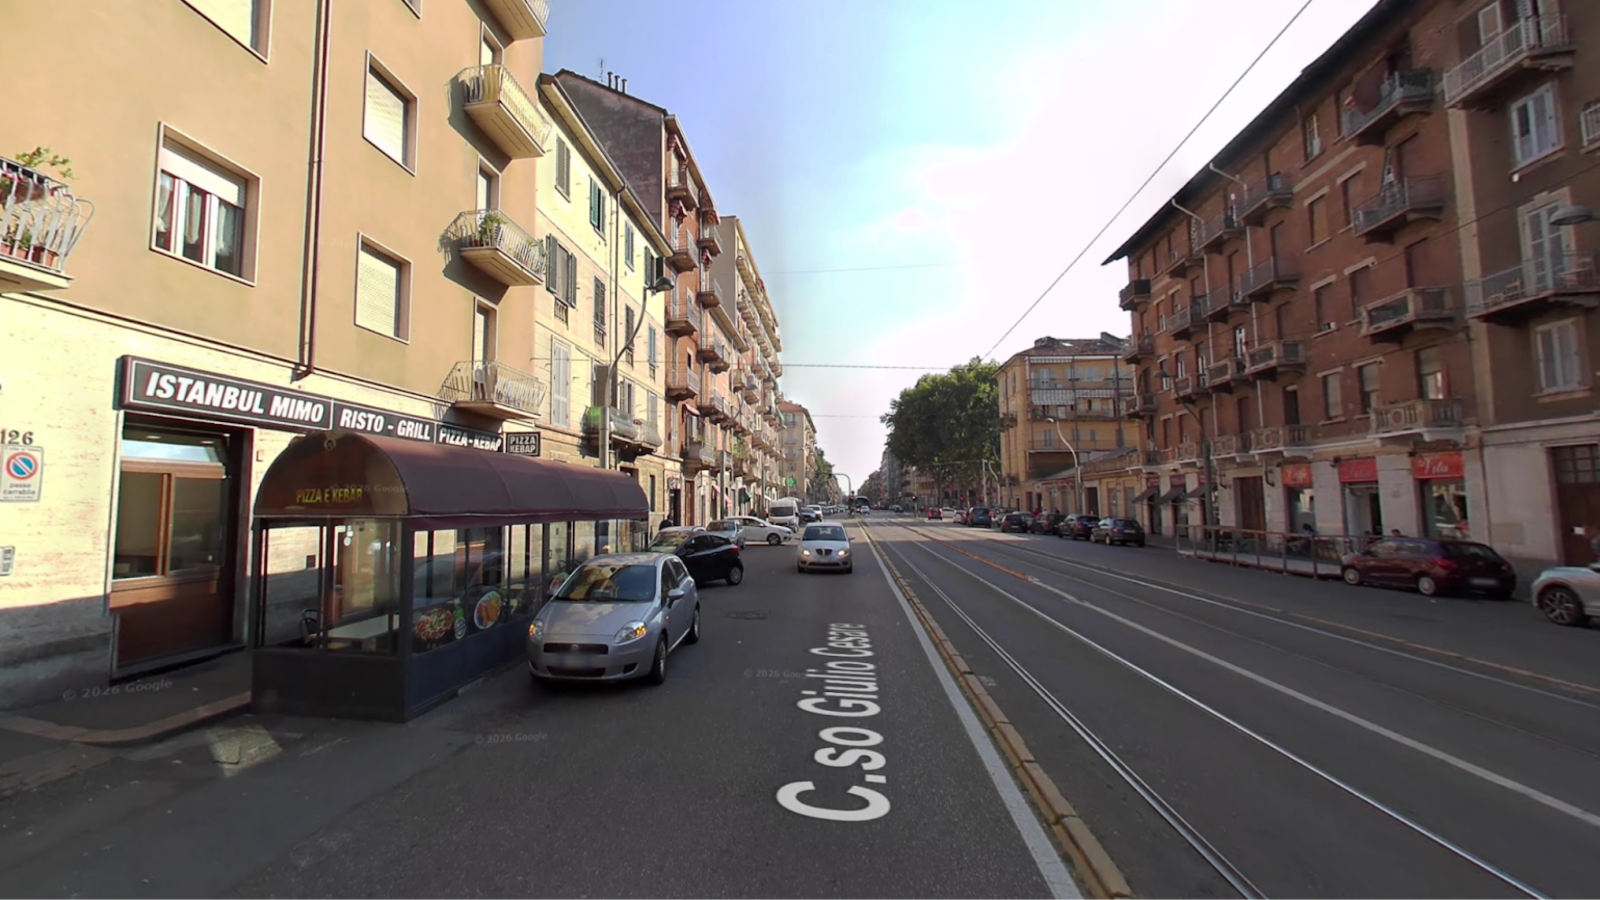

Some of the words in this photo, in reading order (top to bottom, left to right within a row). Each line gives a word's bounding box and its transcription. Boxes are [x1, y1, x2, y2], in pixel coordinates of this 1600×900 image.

[146, 371, 265, 415] ISTANBUL
[269, 394, 325, 423] MIMO
[0, 429, 34, 445] 126
[340, 408, 385, 433] RISTO
[396, 419, 431, 440] GRILL
[509, 436, 536, 445] PIZZA
[509, 444, 536, 453] KEBAP
[296, 488, 322, 503] PIZZA
[809, 623, 875, 657] Cesare
[796, 661, 882, 718] Giulio
[776, 726, 891, 821] C.so
